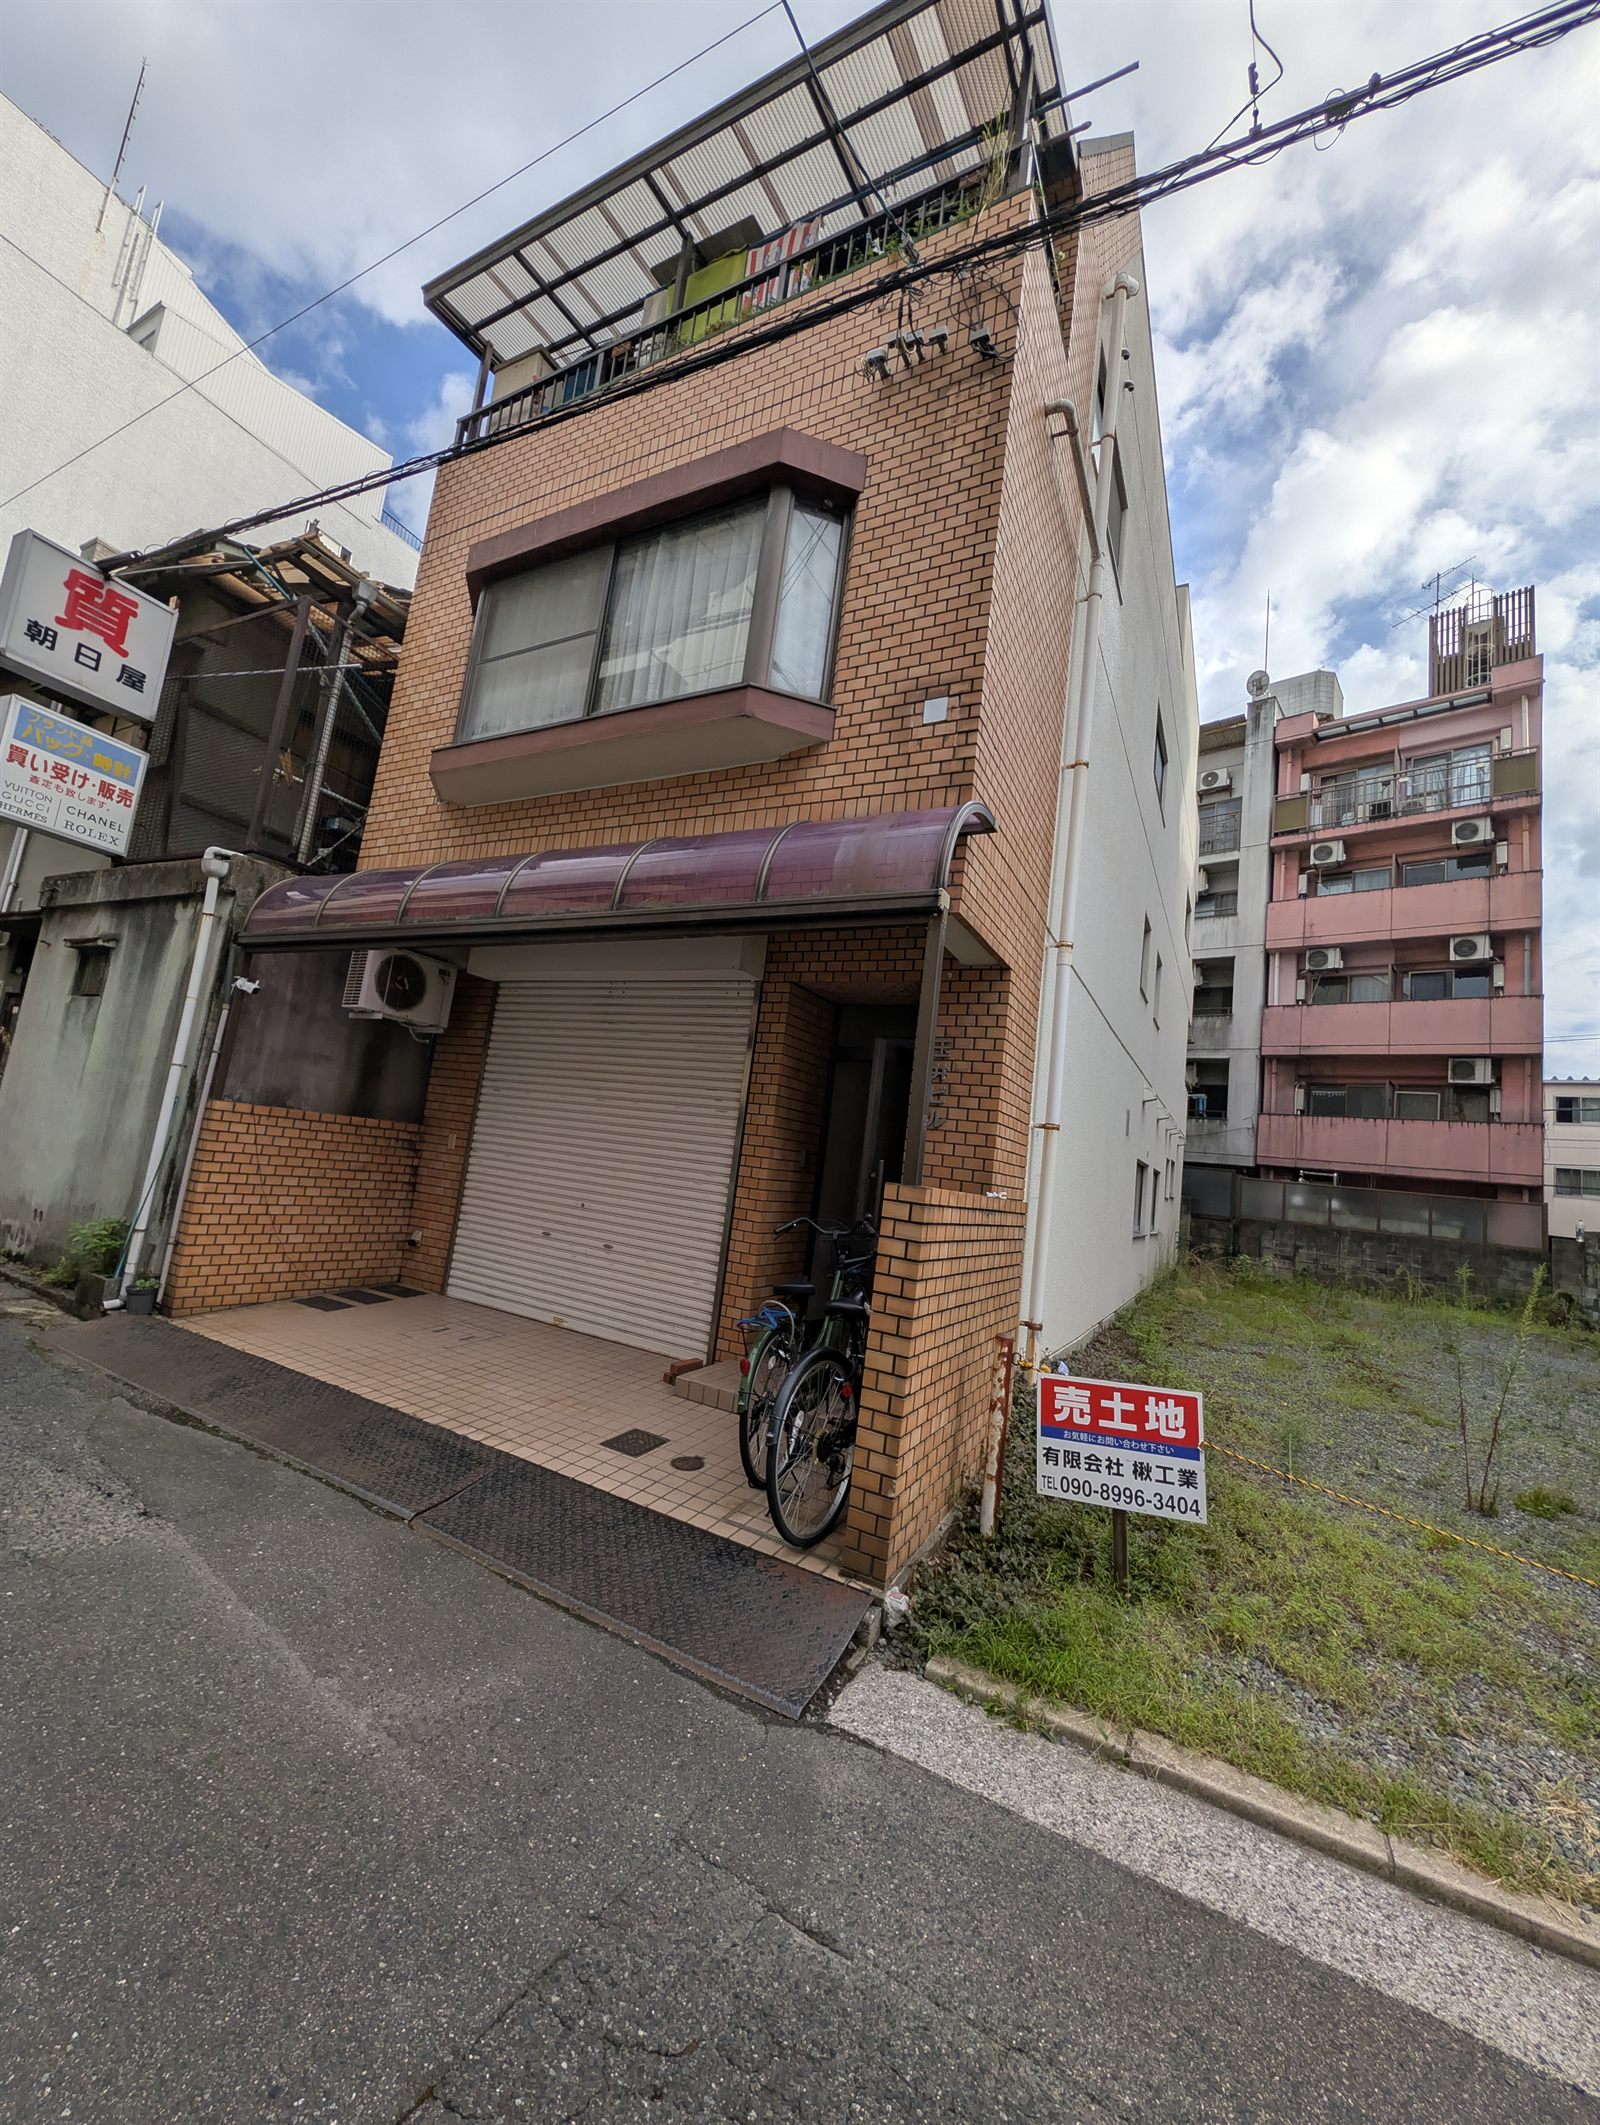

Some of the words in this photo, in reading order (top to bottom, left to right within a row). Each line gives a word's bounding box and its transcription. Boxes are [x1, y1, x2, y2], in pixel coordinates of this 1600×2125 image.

[55, 568, 139, 658] 質
[24, 618, 147, 693] 朝日屋
[4, 780, 53, 804] VUITTON
[6, 743, 135, 809] 買い受け・販売
[1, 791, 50, 814] GUCCI
[63, 819, 120, 847] ROLEX
[66, 805, 125, 833] CHANEL
[1053, 1385, 1187, 1439] 売土地
[1063, 1429, 1175, 1455] お気軽にお問い合わせ下さい
[1041, 1446, 1125, 1478] 有限会社
[1041, 1475, 1058, 1491] TEL
[1060, 1475, 1201, 1517] 090-8996-3404
